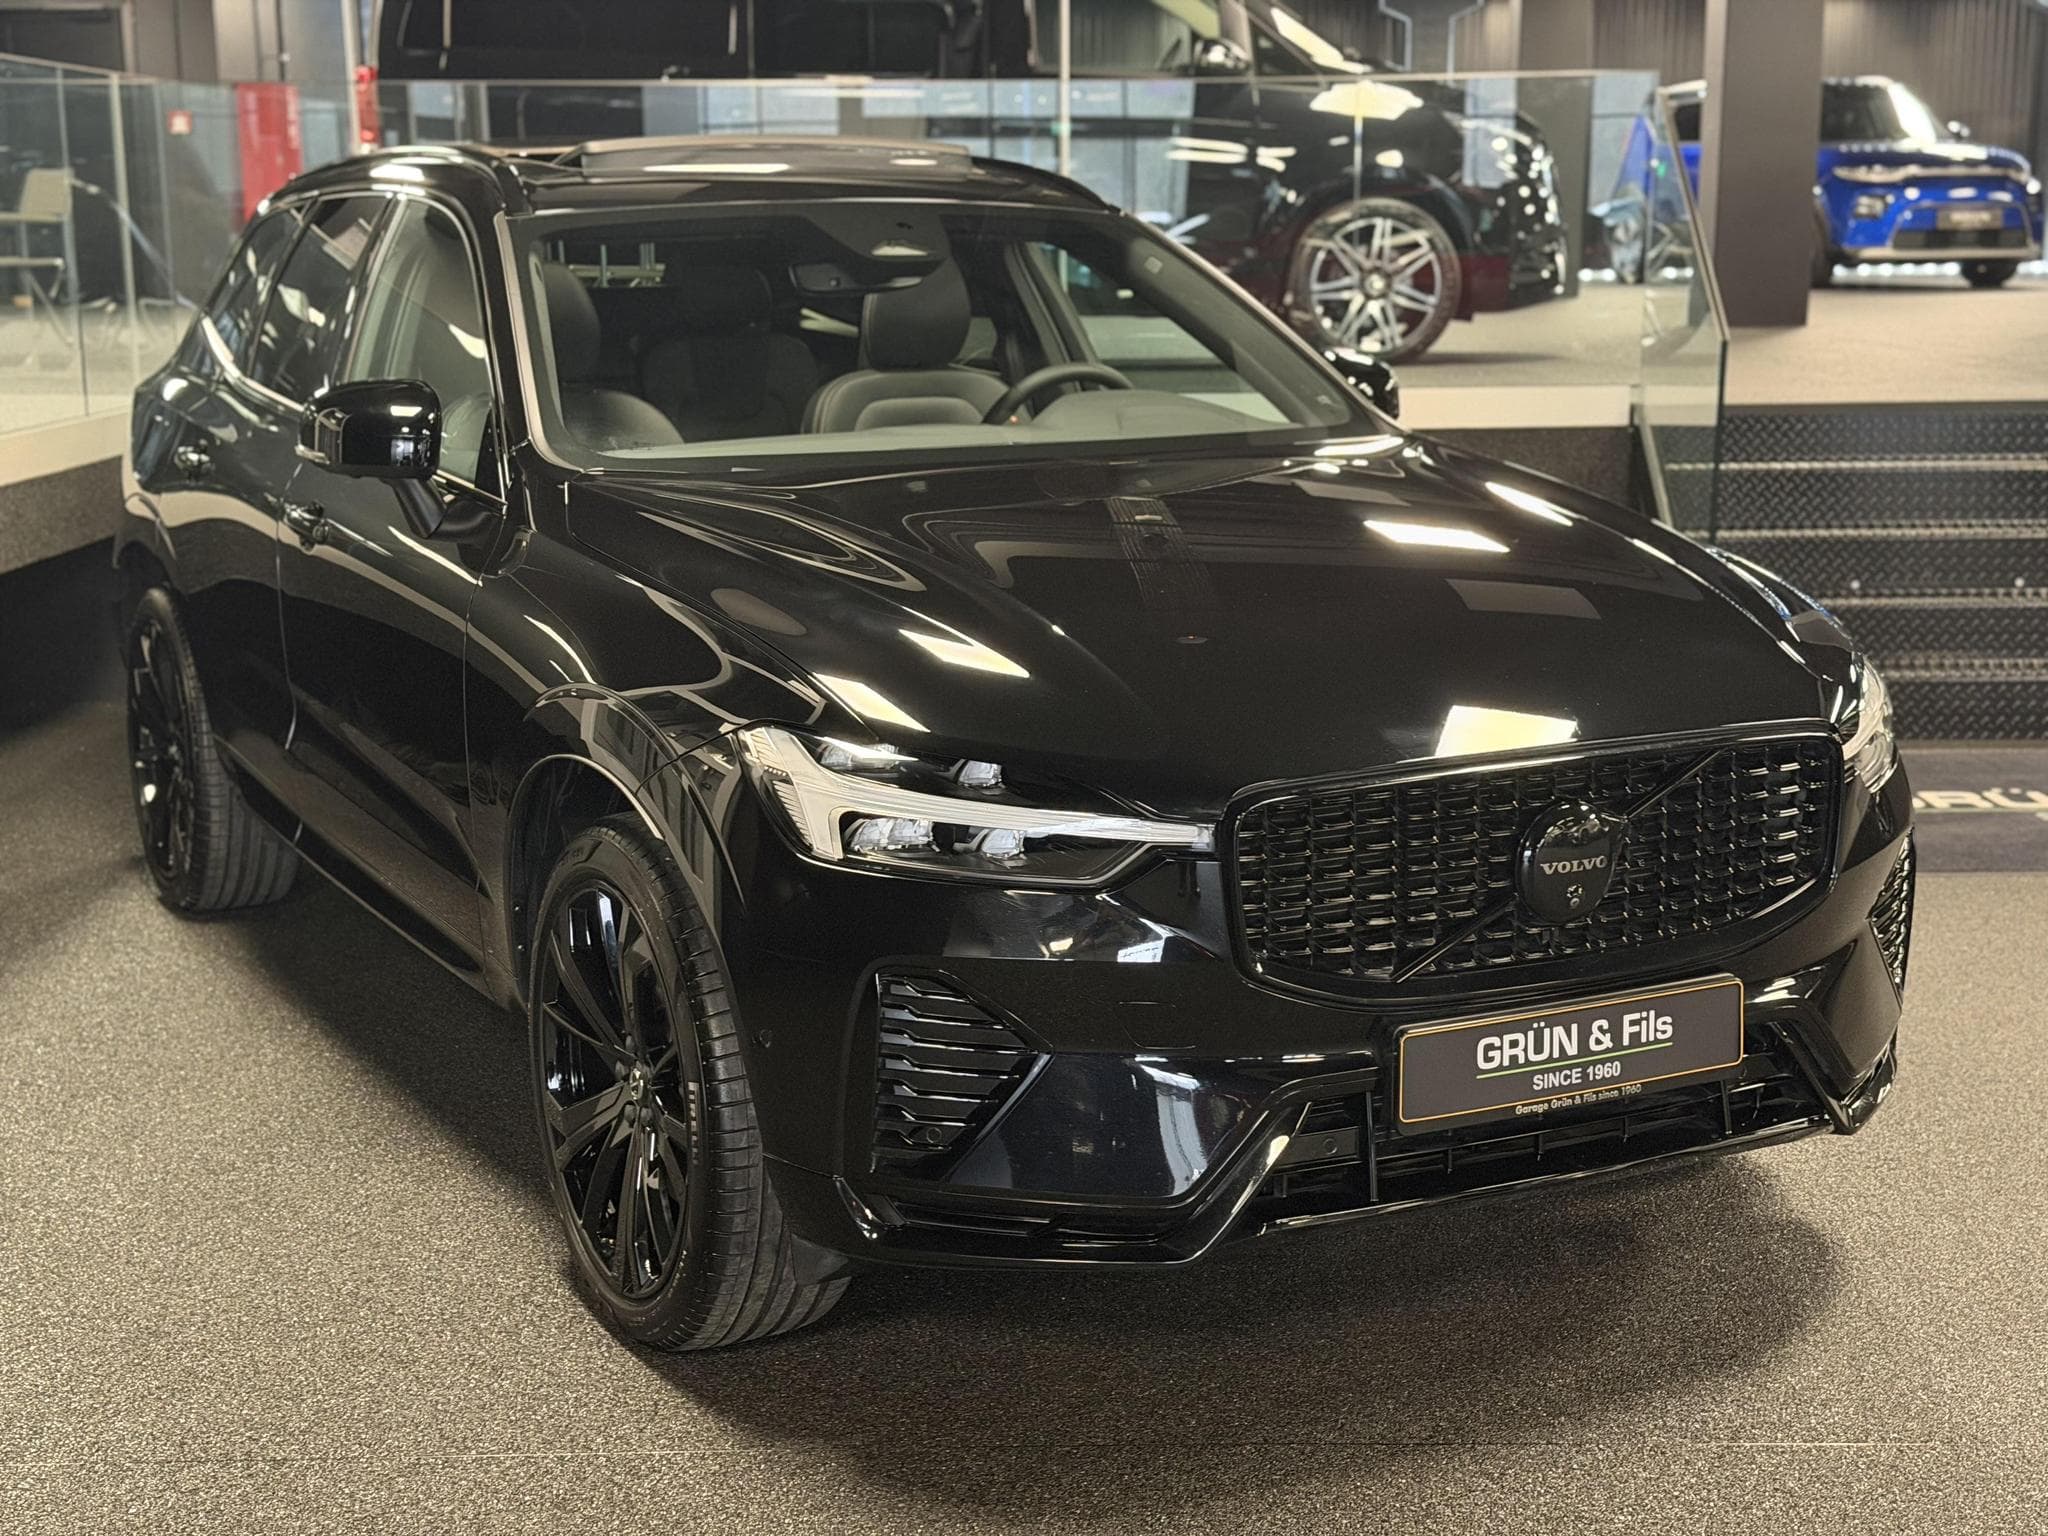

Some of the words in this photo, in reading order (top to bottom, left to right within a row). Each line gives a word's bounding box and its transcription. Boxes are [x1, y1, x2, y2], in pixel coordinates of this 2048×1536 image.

[1540, 855, 1608, 875] VOLVO
[1476, 1021, 1578, 1070] GRÜN
[1588, 1019, 1613, 1052] &
[1622, 1009, 1674, 1046] Fils
[1532, 1067, 1582, 1091] SINCE
[1586, 1060, 1622, 1081] 1960
[1515, 1102, 1549, 1115] Garage
[1550, 1097, 1574, 1109] Grün
[1574, 1096, 1582, 1105] &
[1598, 1088, 1619, 1101] since
[1621, 1083, 1643, 1097] 1960
